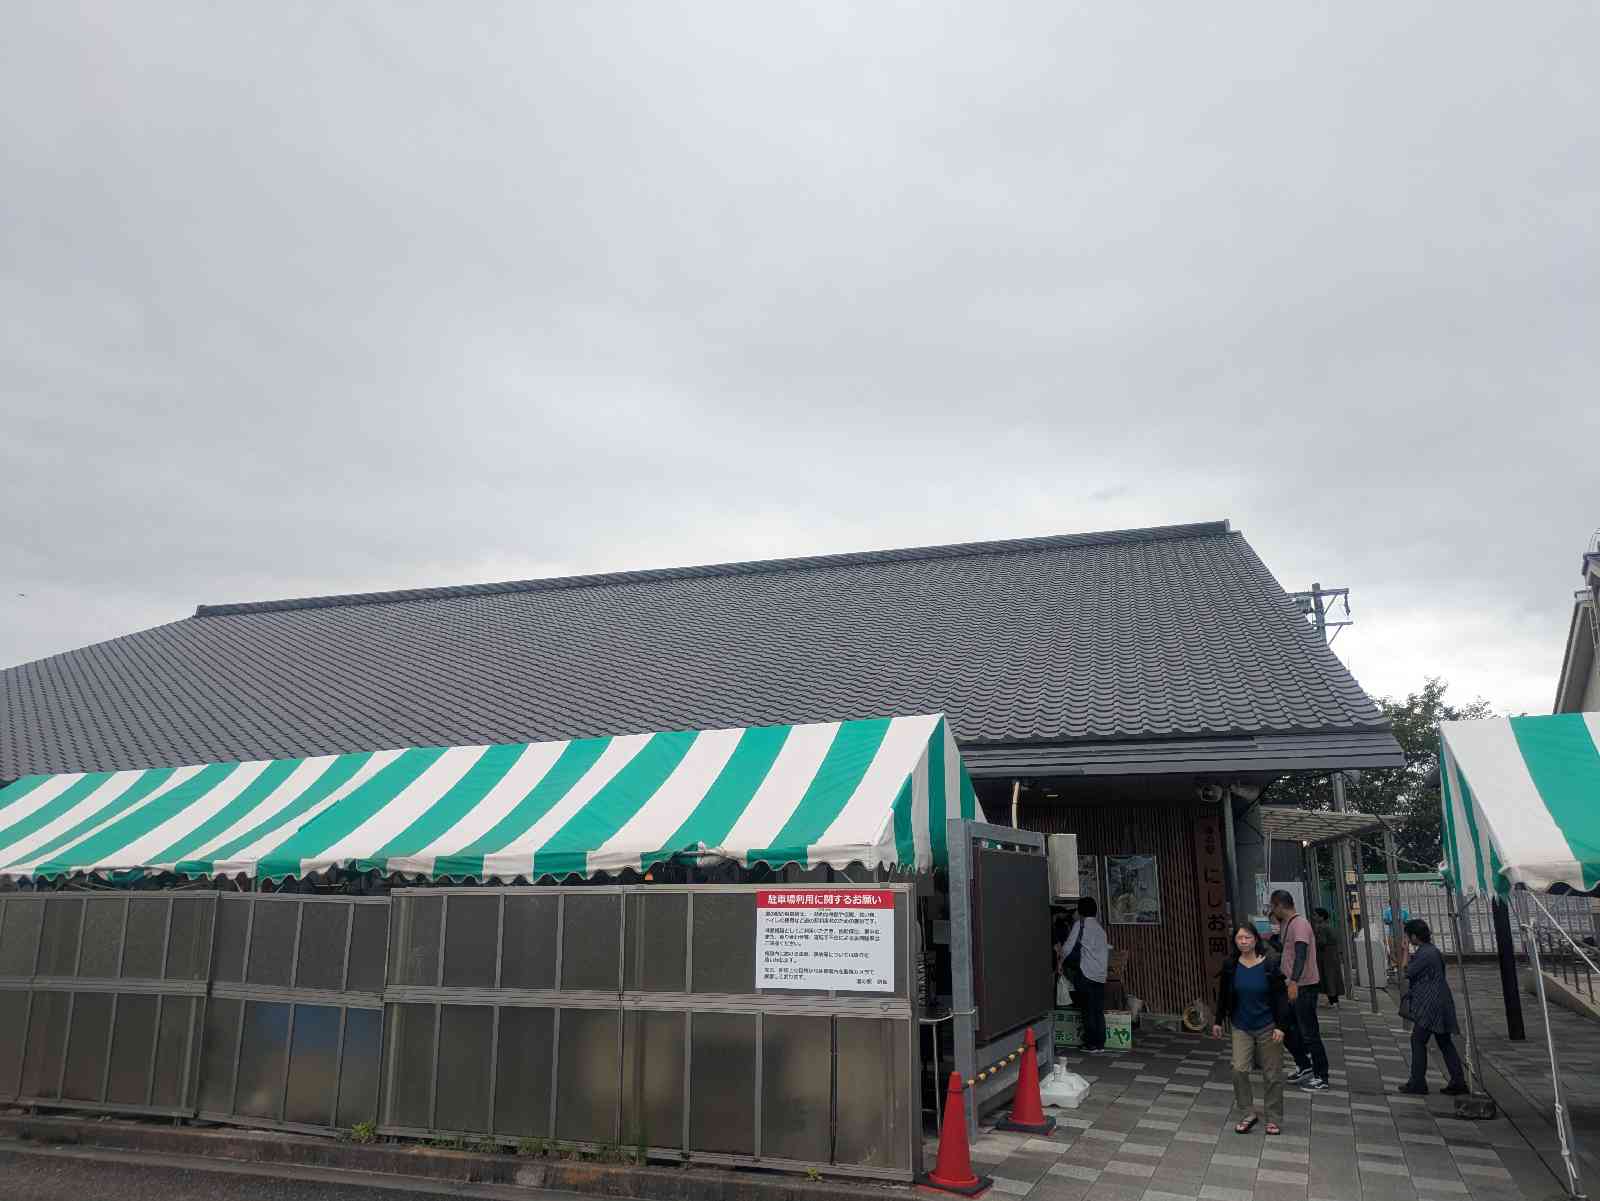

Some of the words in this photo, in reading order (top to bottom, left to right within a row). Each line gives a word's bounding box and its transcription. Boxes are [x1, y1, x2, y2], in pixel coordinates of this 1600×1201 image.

[768, 894, 882, 905] 駐車場利用に関するお願い
[1204, 865, 1228, 1001] にしお岡
